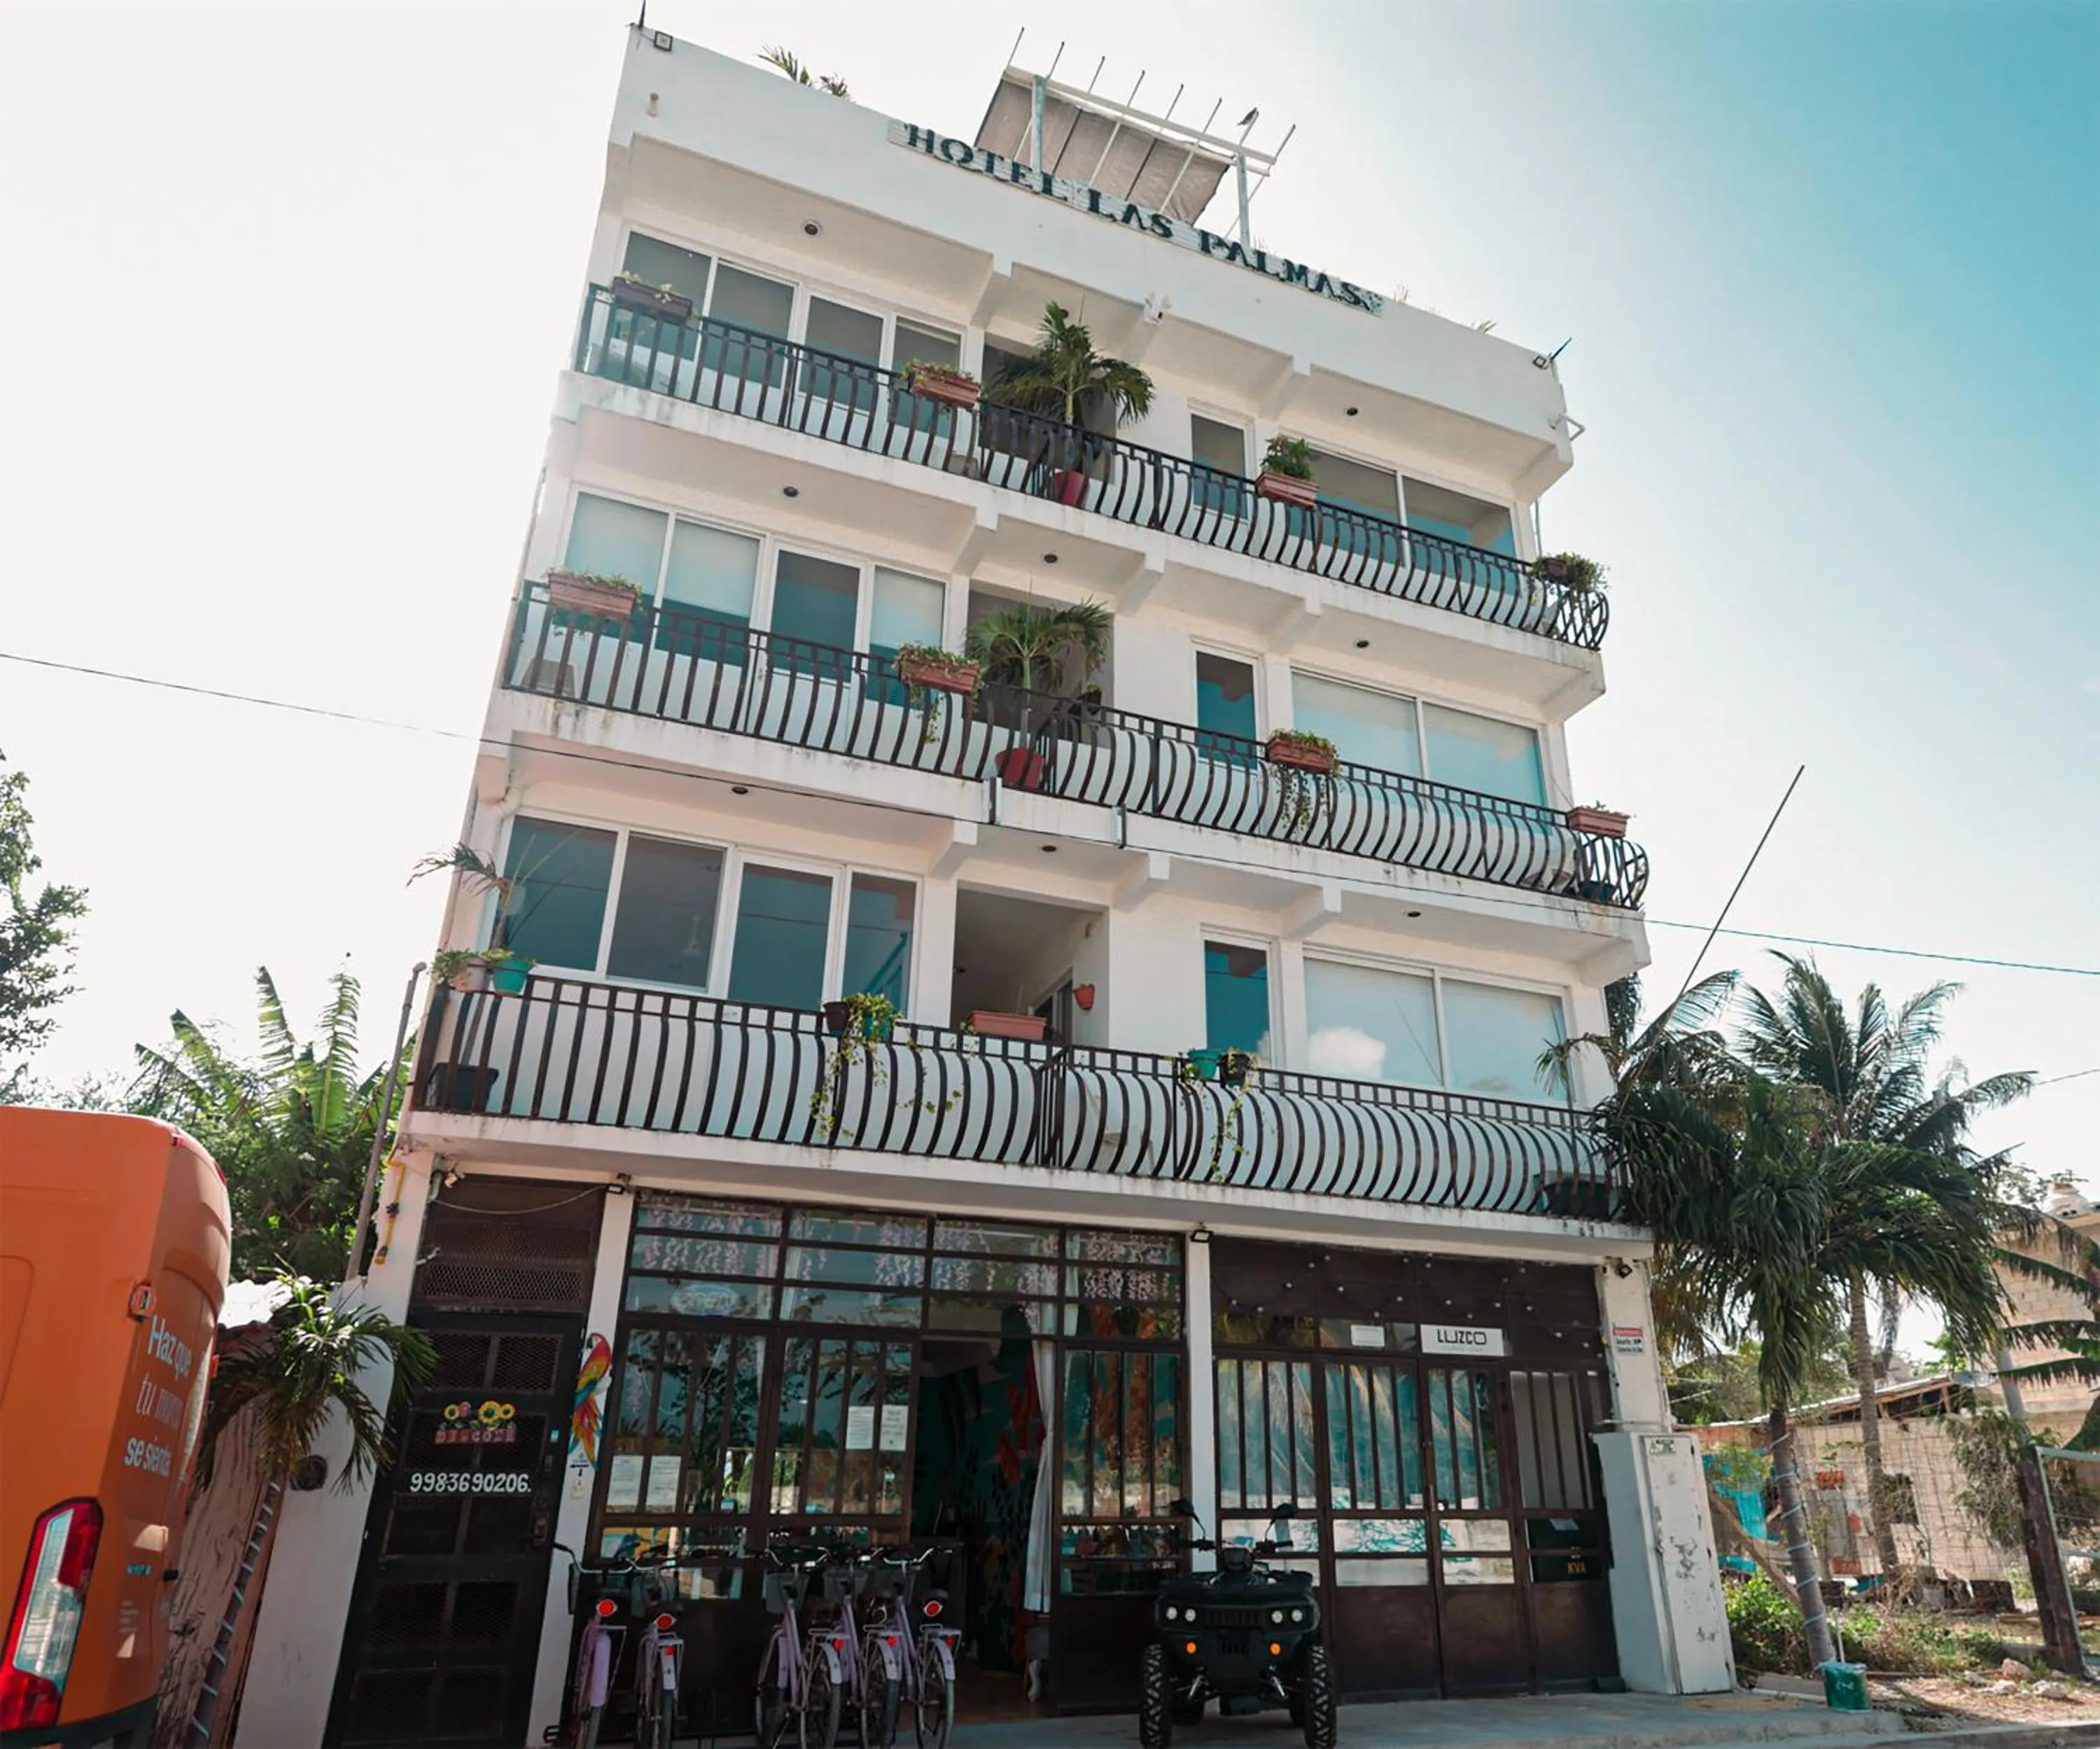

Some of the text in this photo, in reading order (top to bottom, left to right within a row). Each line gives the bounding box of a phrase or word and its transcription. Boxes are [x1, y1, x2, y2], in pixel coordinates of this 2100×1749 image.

[904, 123, 1373, 312] HOTEL LAS PALMAS
[148, 1314, 177, 1365] Haz
[1437, 1328, 1488, 1345] LUZCO
[136, 1371, 158, 1416] tu
[125, 1437, 145, 1467] se
